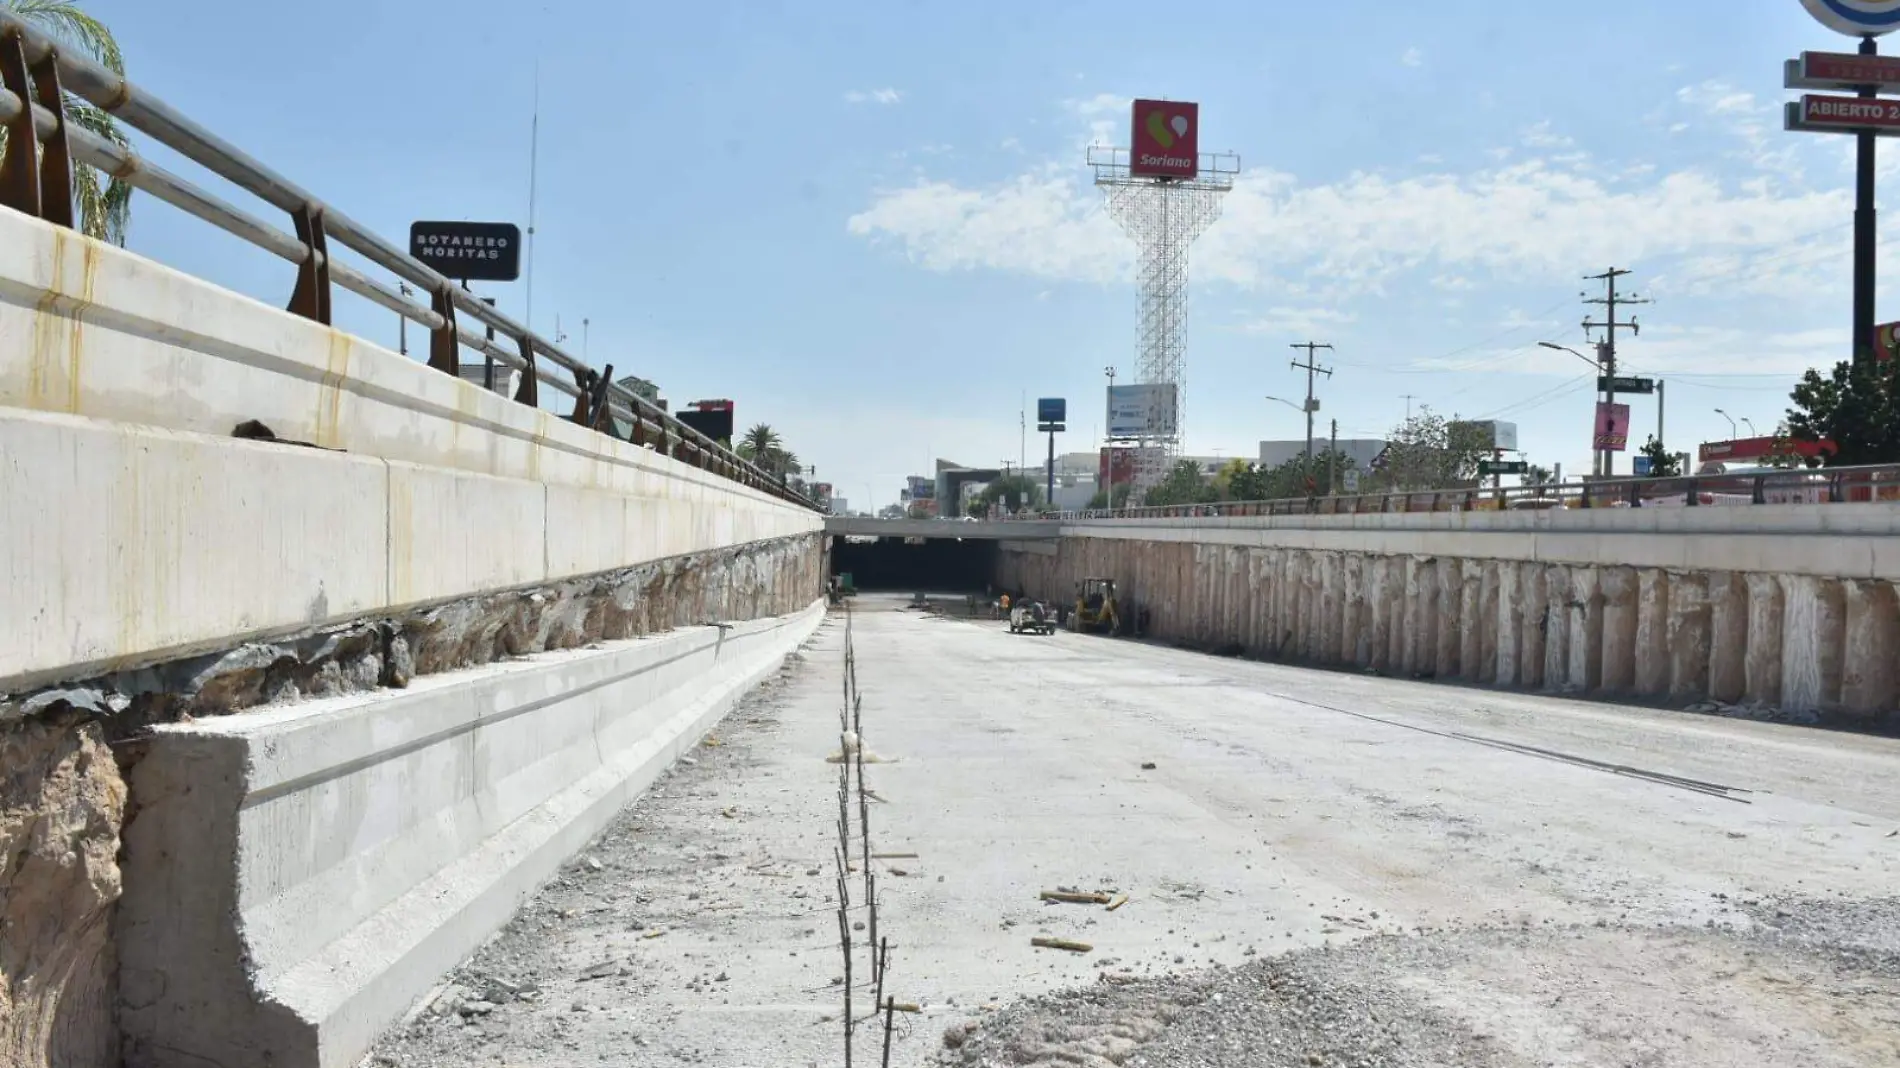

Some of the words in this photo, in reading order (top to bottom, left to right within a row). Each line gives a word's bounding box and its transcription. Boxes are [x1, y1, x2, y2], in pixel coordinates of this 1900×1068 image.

[1808, 101, 1884, 119] ABIERTO
[1888, 105, 1900, 119] 2
[1140, 153, 1191, 168] Soriana
[417, 234, 508, 248] BOTANERO
[422, 246, 499, 259] MORITAS
